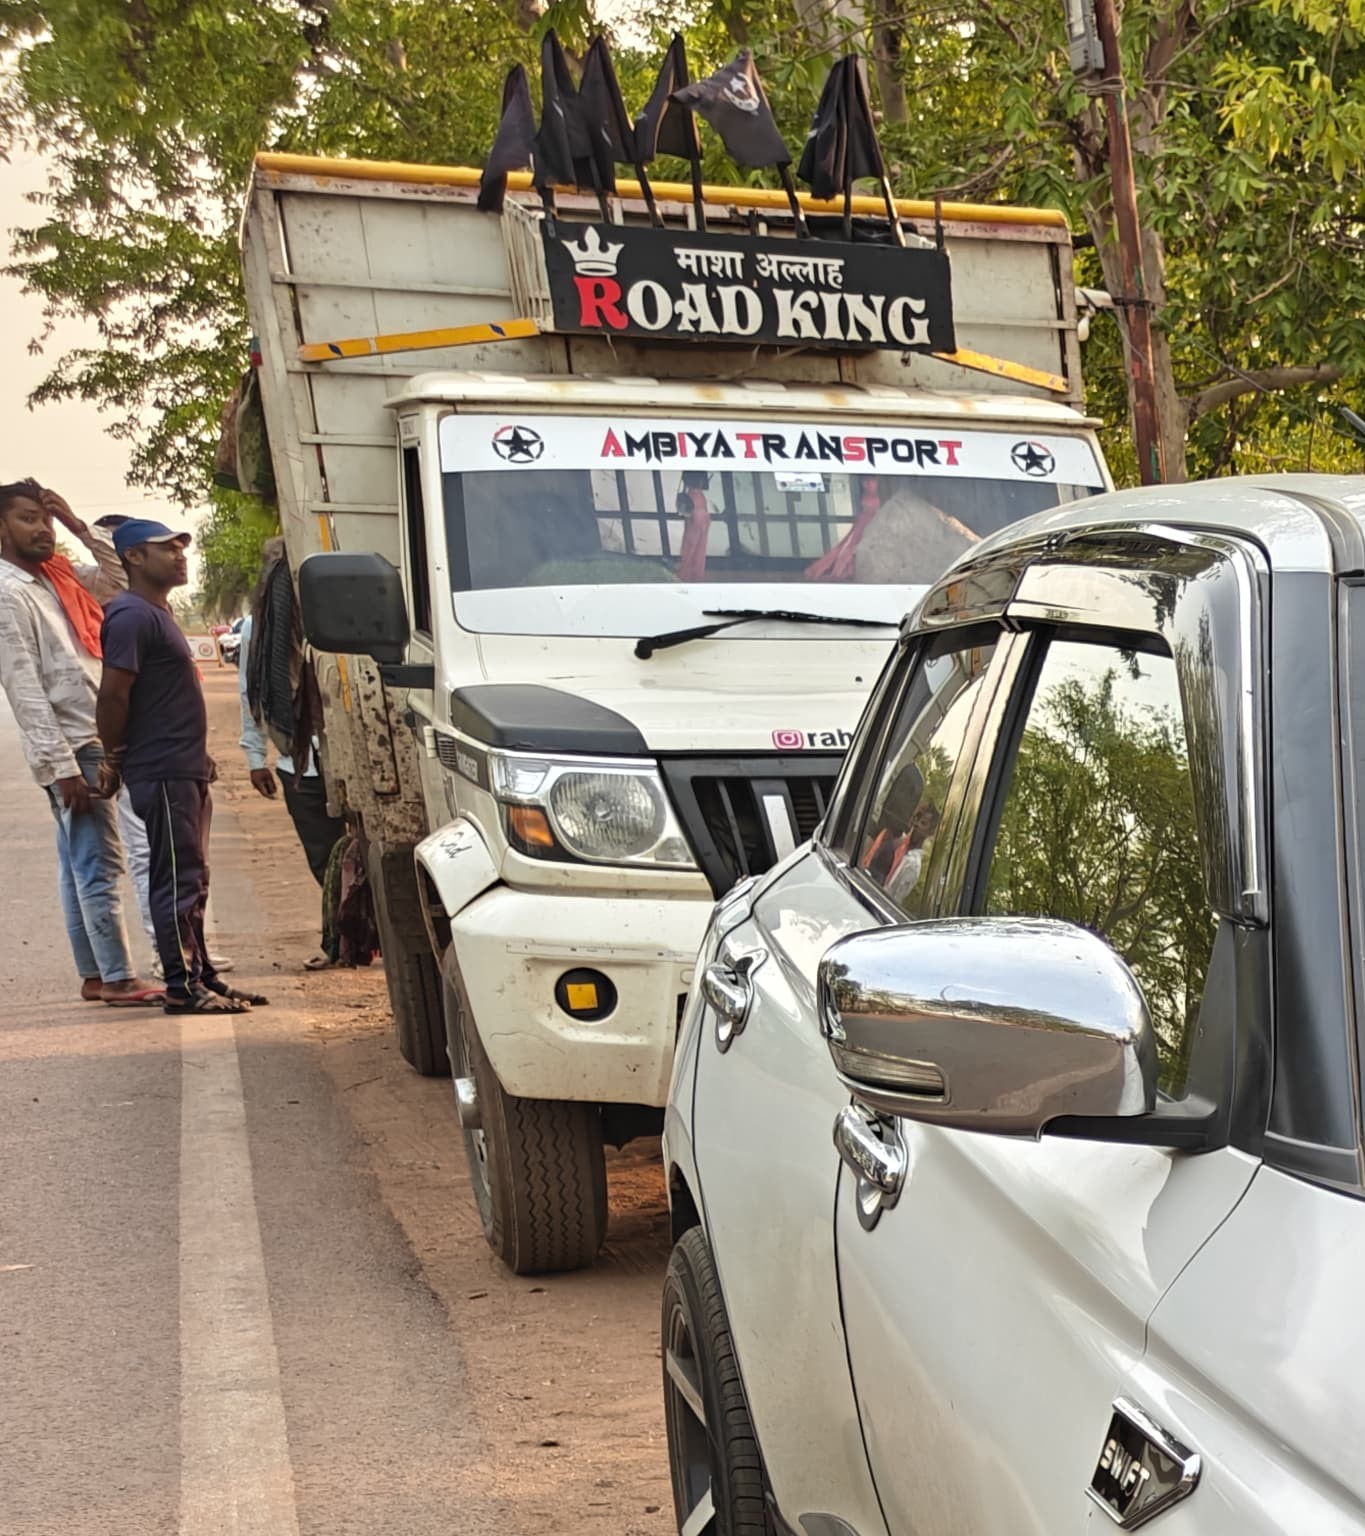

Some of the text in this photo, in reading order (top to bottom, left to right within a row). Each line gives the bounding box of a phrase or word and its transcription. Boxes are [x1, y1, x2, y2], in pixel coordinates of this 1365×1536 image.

[673, 247, 845, 287] माशा अल्लाह
[573, 275, 931, 345] ROAD KING
[1100, 1438, 1151, 1498] SWIFT
